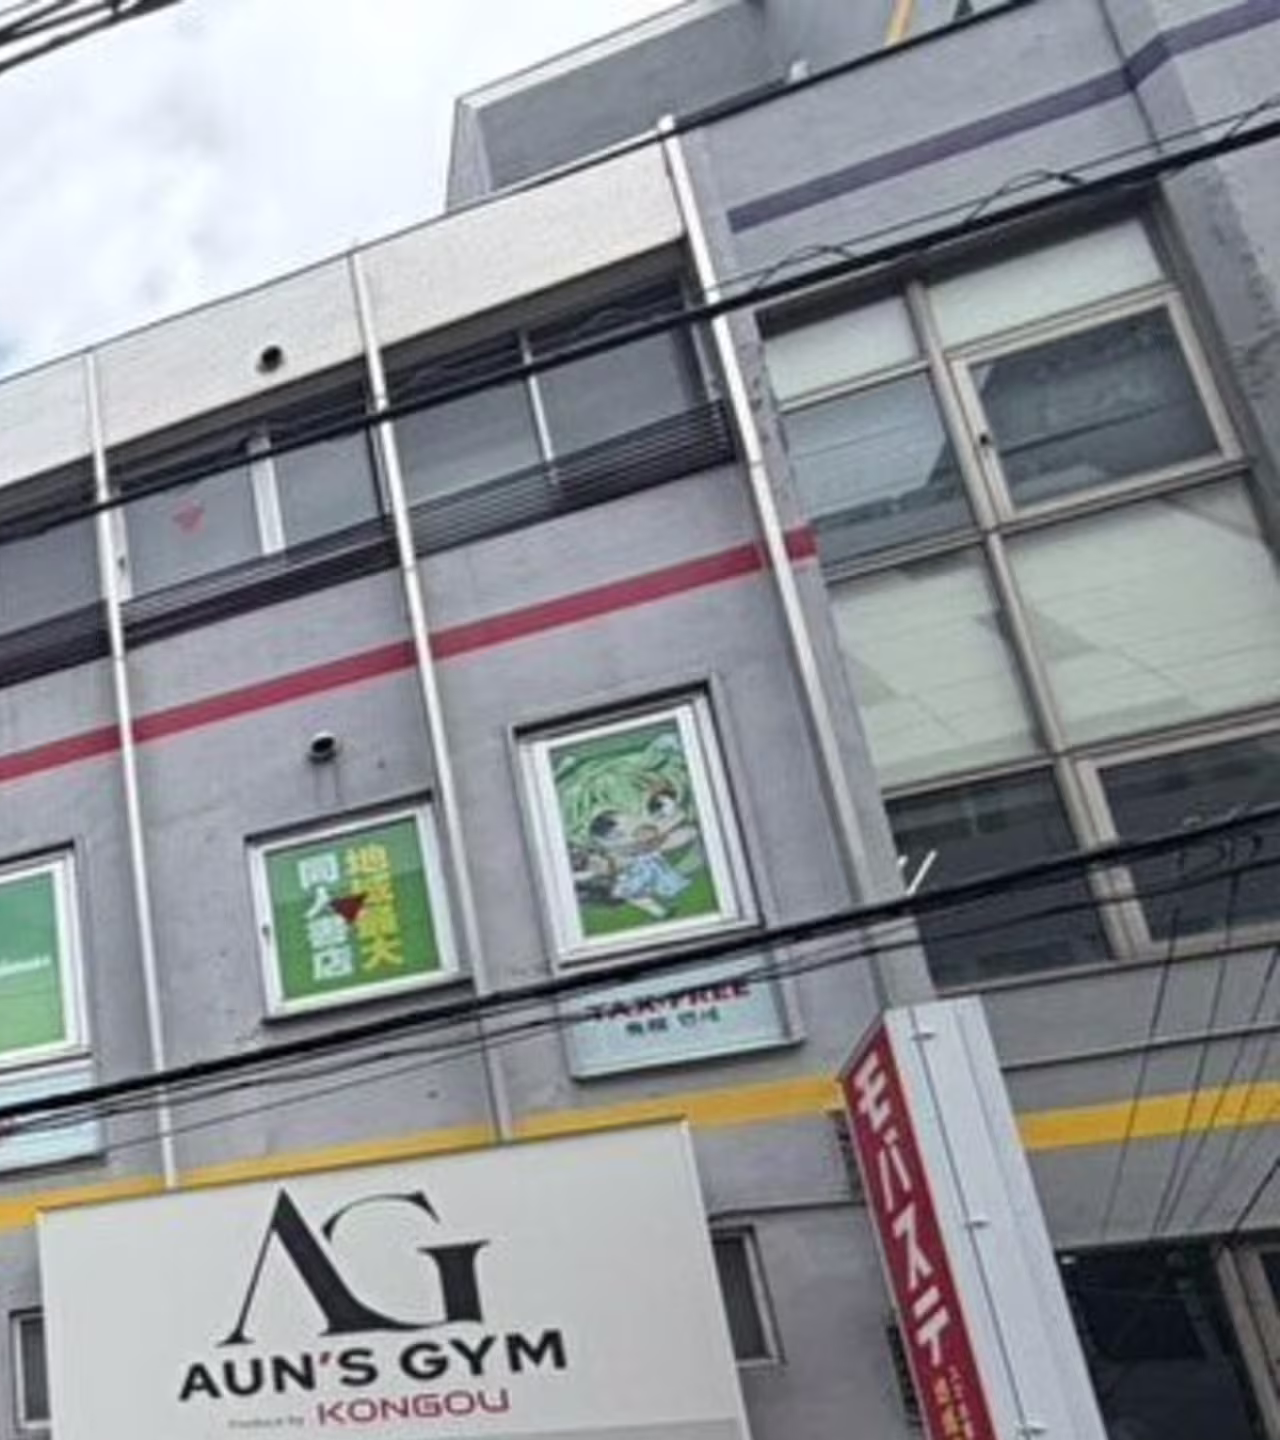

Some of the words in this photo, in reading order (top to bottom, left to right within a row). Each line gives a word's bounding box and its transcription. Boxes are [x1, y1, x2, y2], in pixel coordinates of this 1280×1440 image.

[855, 1052, 952, 1368] モバステ
[177, 1347, 379, 1402] AUN'S
[398, 1330, 568, 1381] GYM
[316, 1387, 512, 1428] KONGOU
